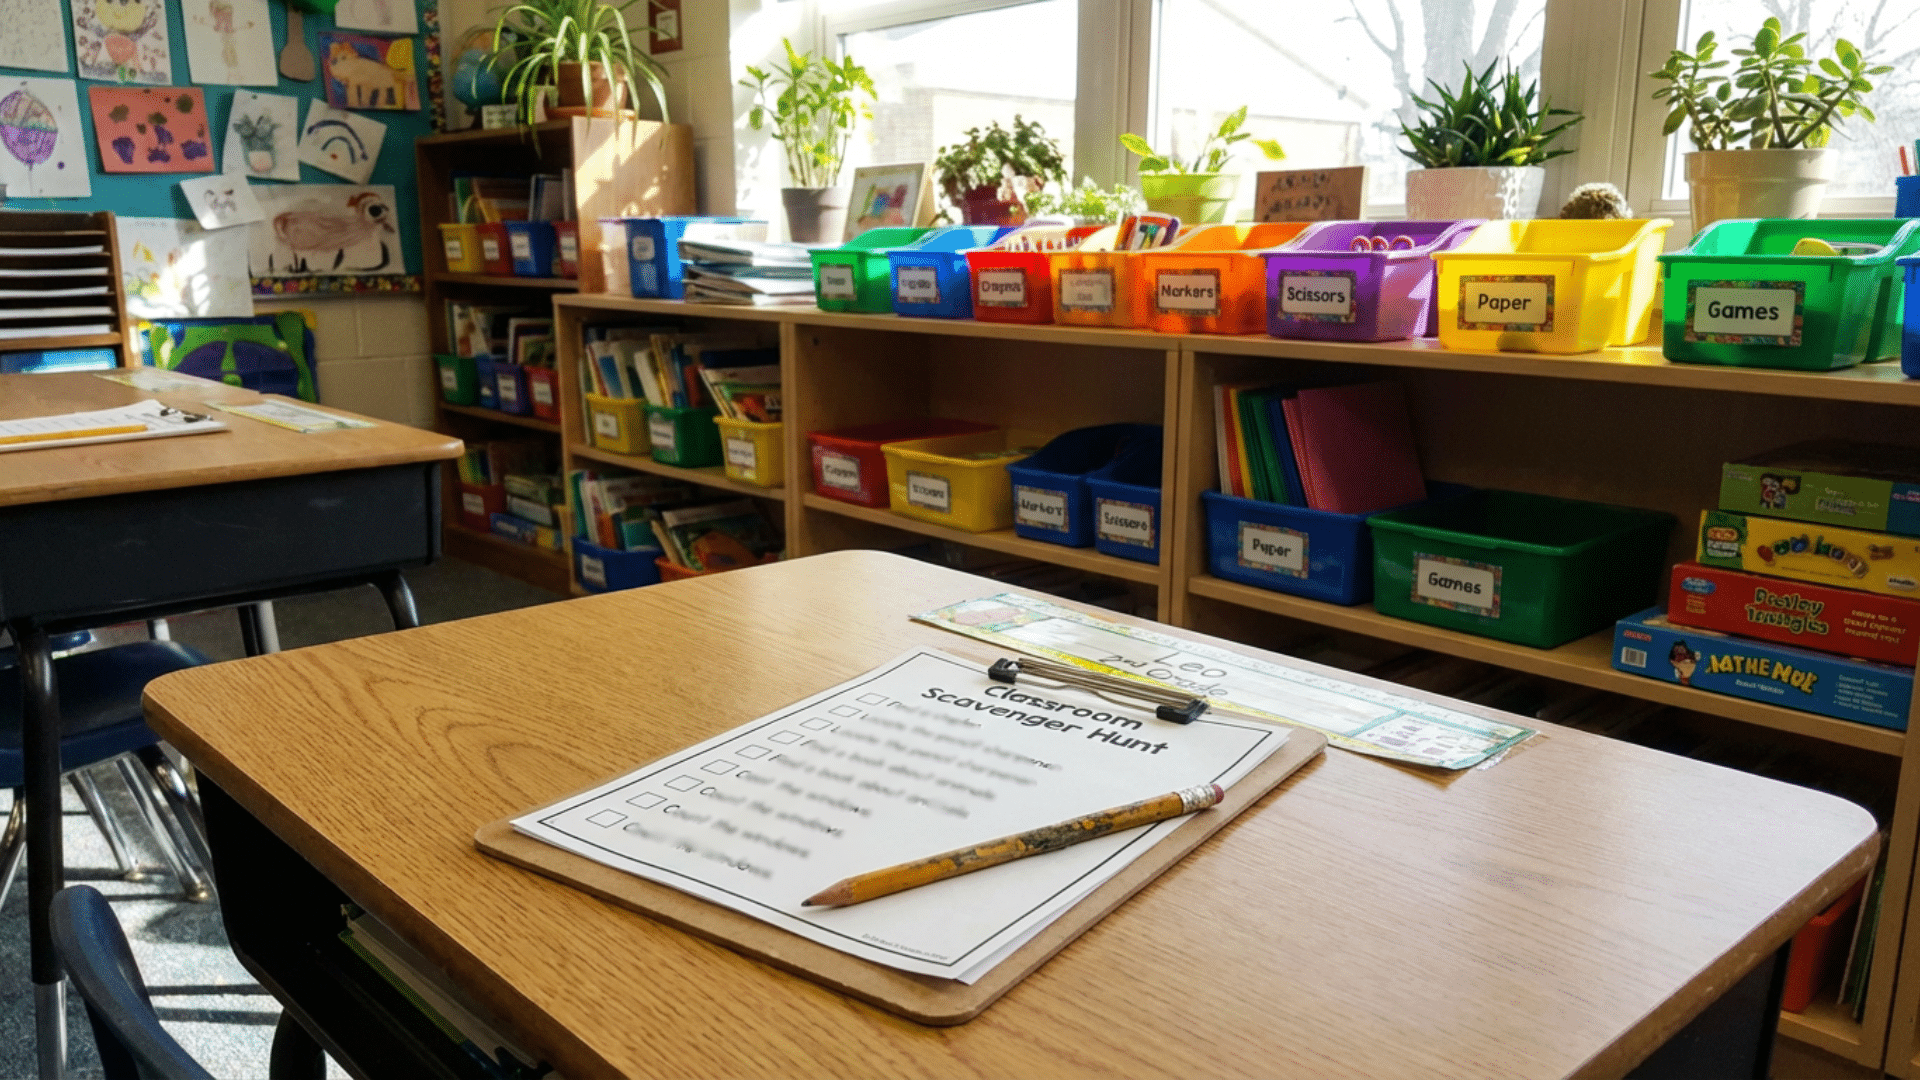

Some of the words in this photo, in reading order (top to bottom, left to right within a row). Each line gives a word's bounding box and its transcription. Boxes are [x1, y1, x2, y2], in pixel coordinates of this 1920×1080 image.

[1287, 286, 1346, 303] Scissors
[1477, 292, 1532, 313] Paper
[1707, 300, 1780, 321] Games
[1153, 651, 1228, 679] Leo
[984, 684, 1144, 731] Classroom
[921, 686, 1084, 736] Scavenger
[1087, 727, 1170, 756] Hunt
